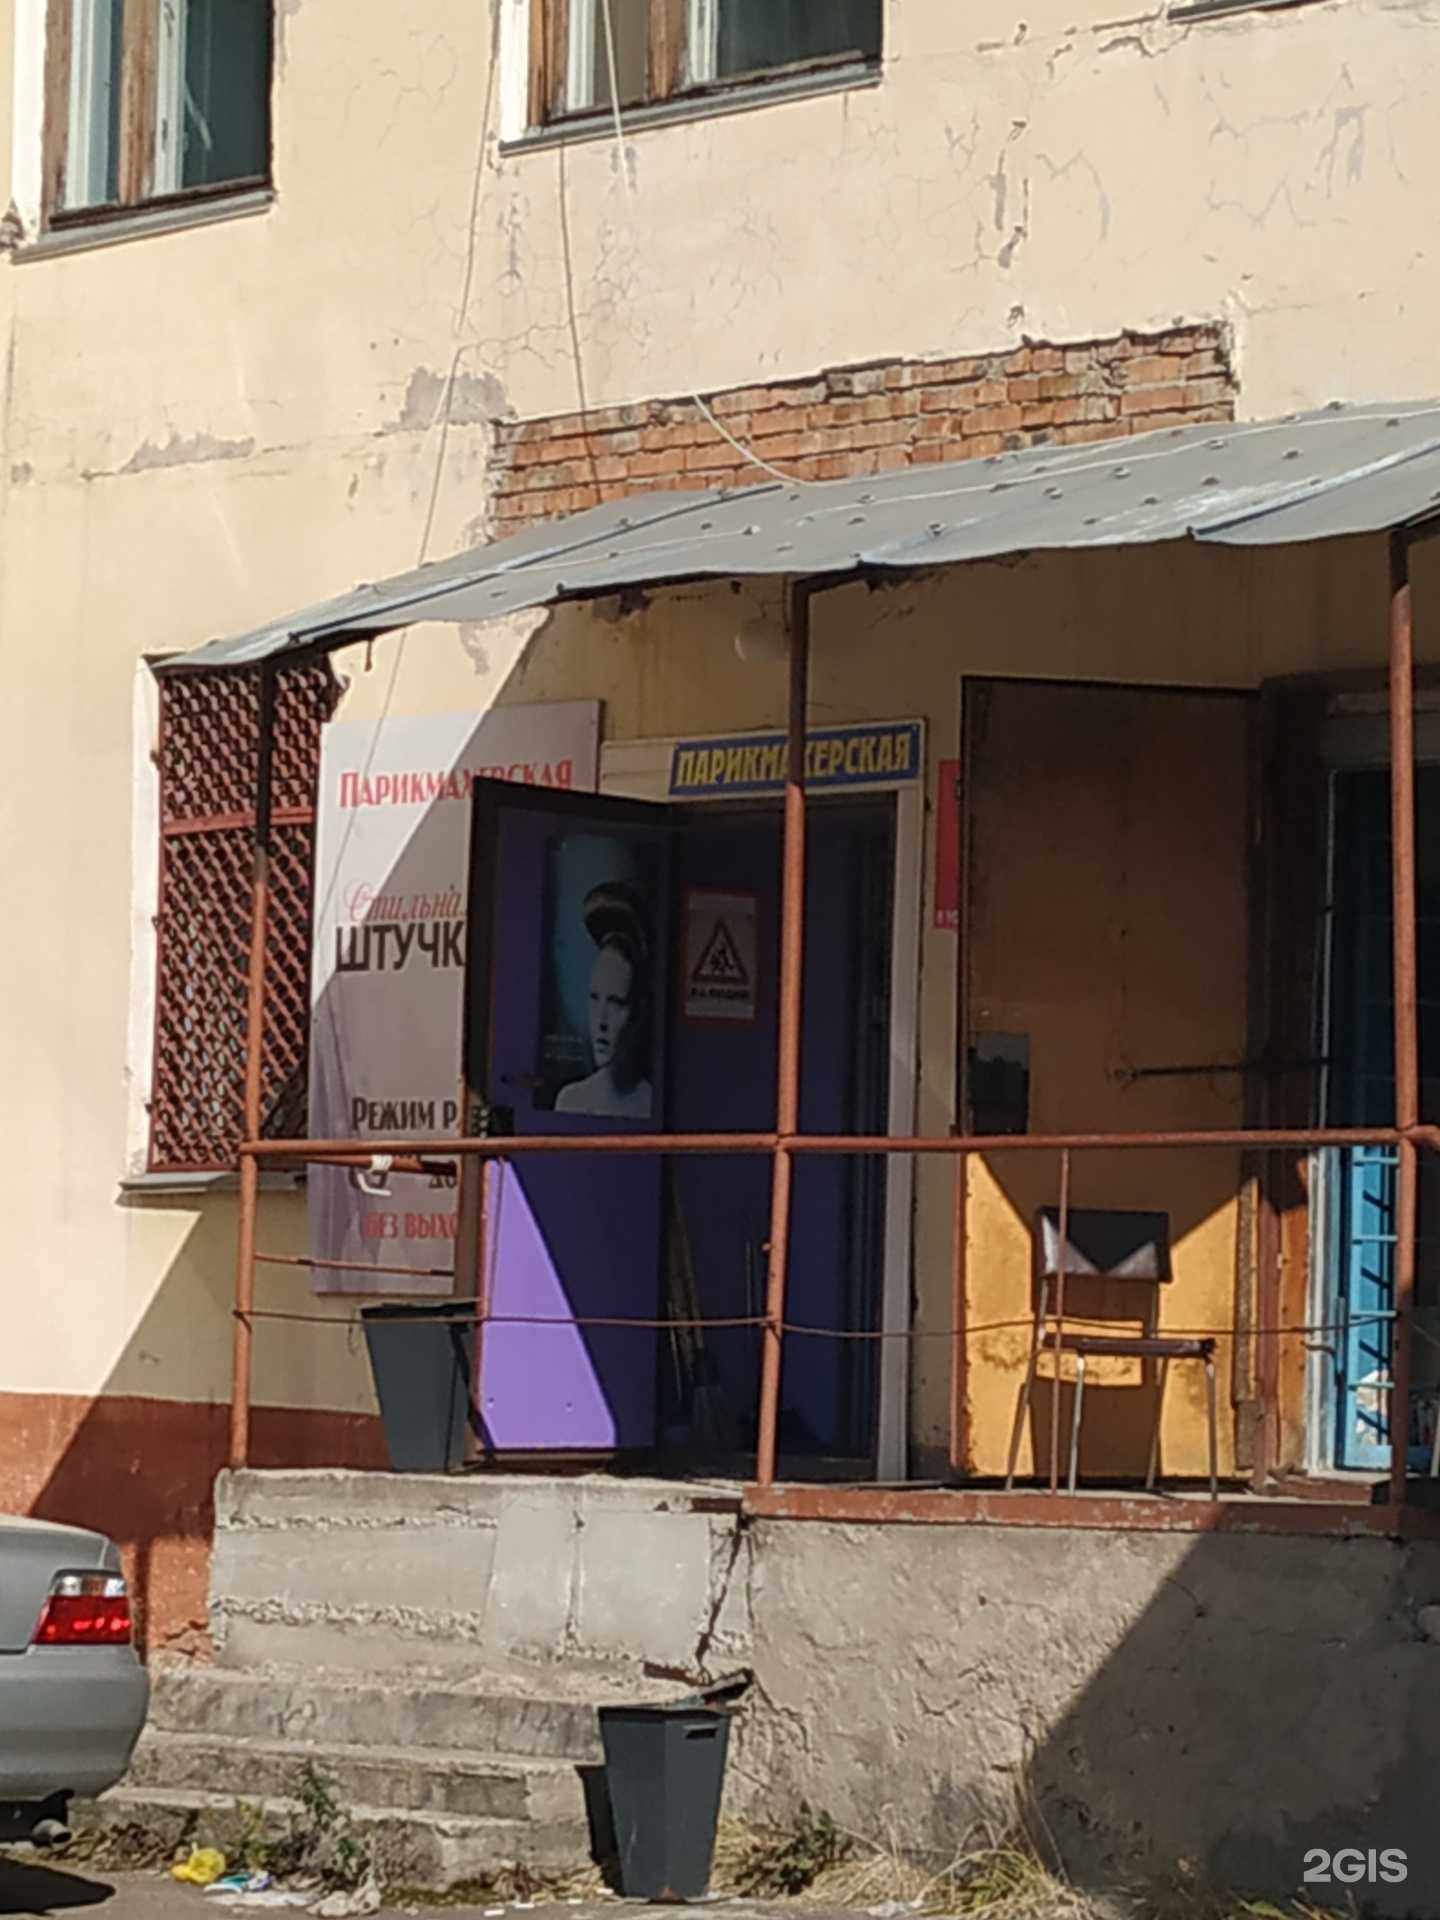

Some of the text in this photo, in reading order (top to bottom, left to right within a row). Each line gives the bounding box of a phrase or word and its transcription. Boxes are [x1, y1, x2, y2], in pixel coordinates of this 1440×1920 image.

[340, 760, 572, 808] ПАРИКМАХСКАЯ
[345, 882, 465, 922] Стильна
[336, 920, 466, 972] ШТУЧК
[351, 1097, 463, 1131] РЕЖИМ Р
